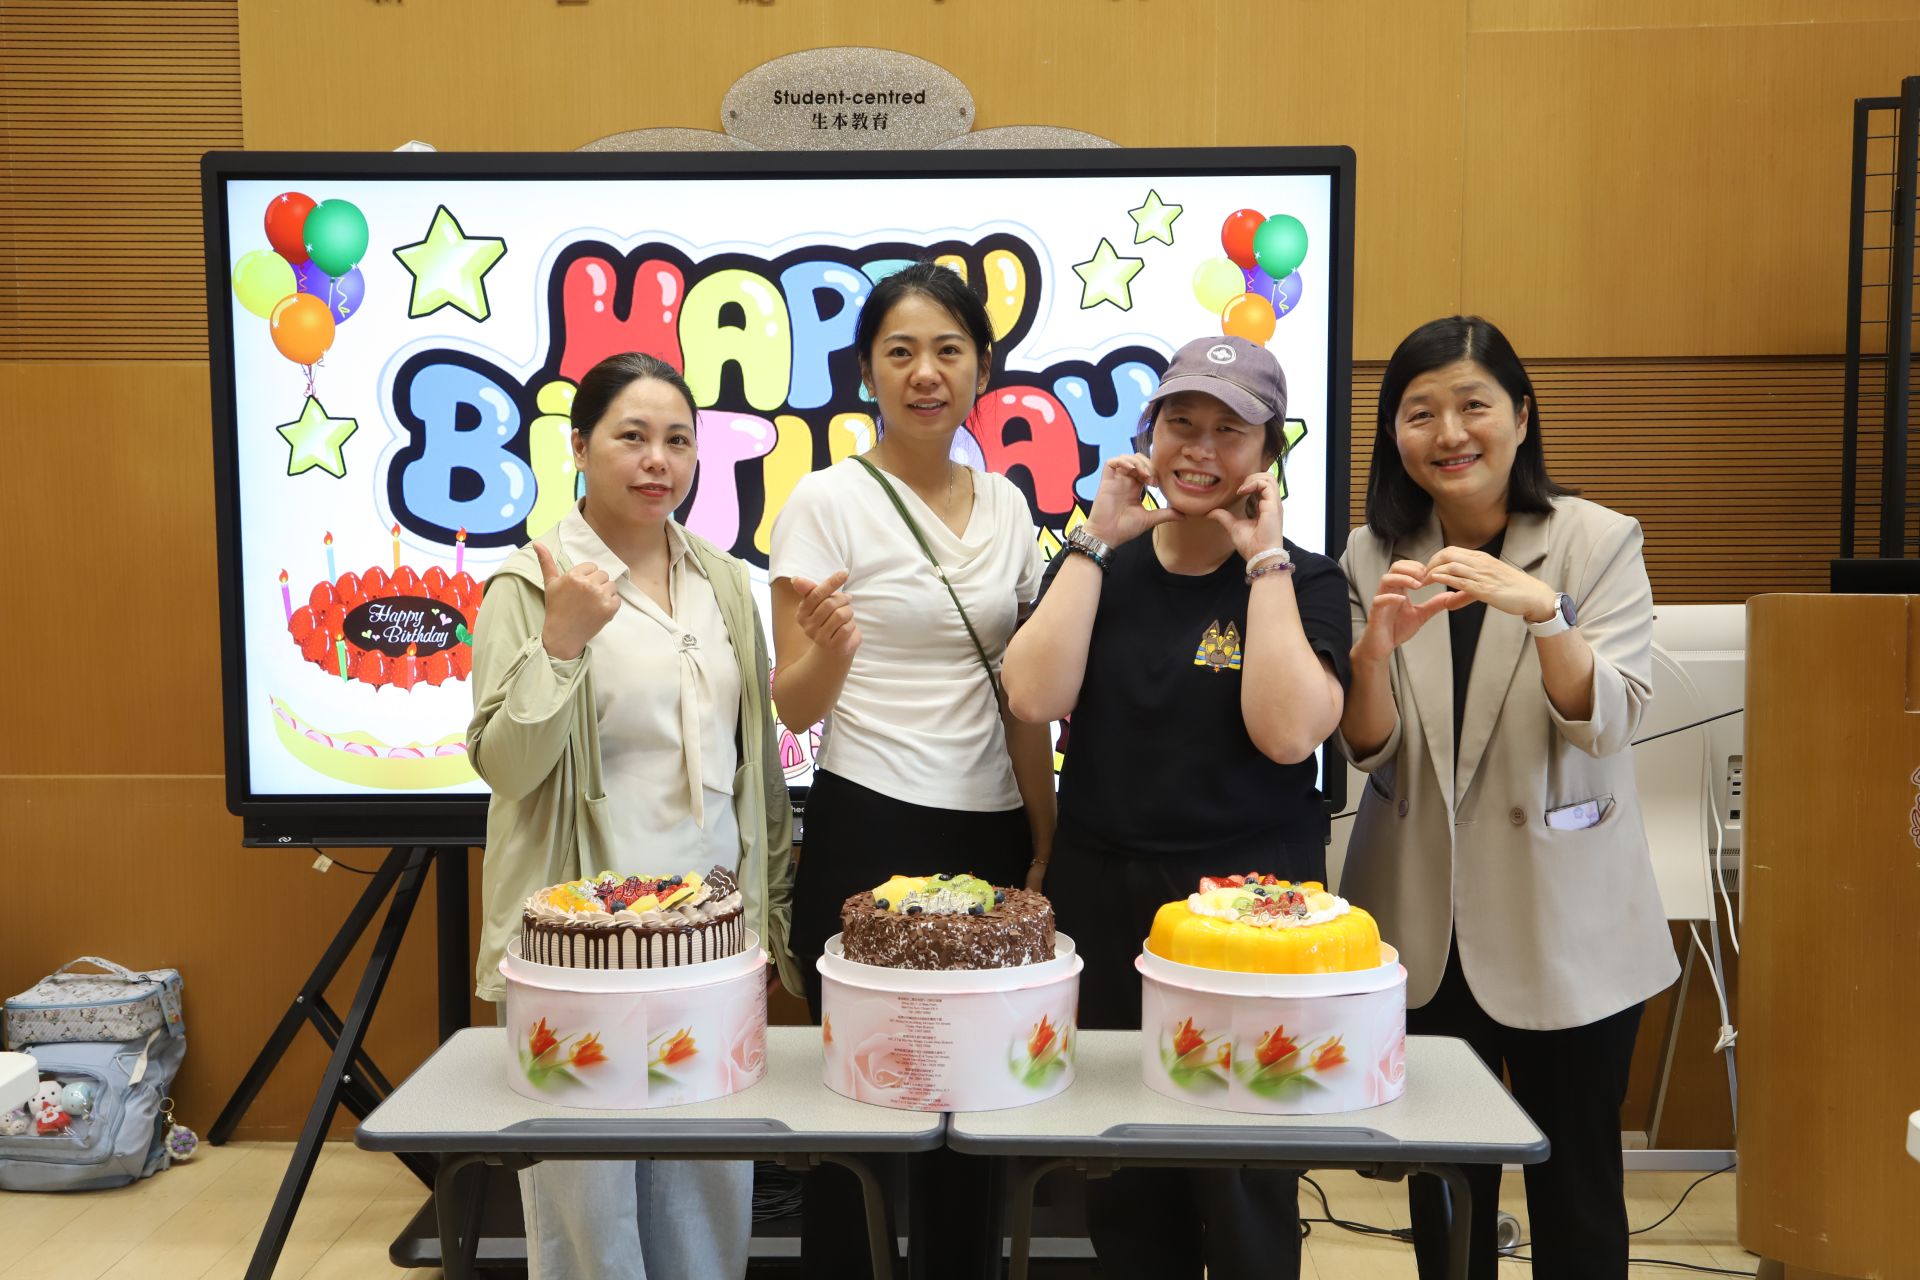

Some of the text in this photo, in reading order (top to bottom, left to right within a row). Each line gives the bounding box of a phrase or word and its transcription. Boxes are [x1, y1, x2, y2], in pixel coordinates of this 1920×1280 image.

[773, 89, 926, 105] Student-centred
[811, 112, 889, 131] 生本教育
[368, 603, 425, 628] Happy
[382, 625, 450, 648] Birthday
